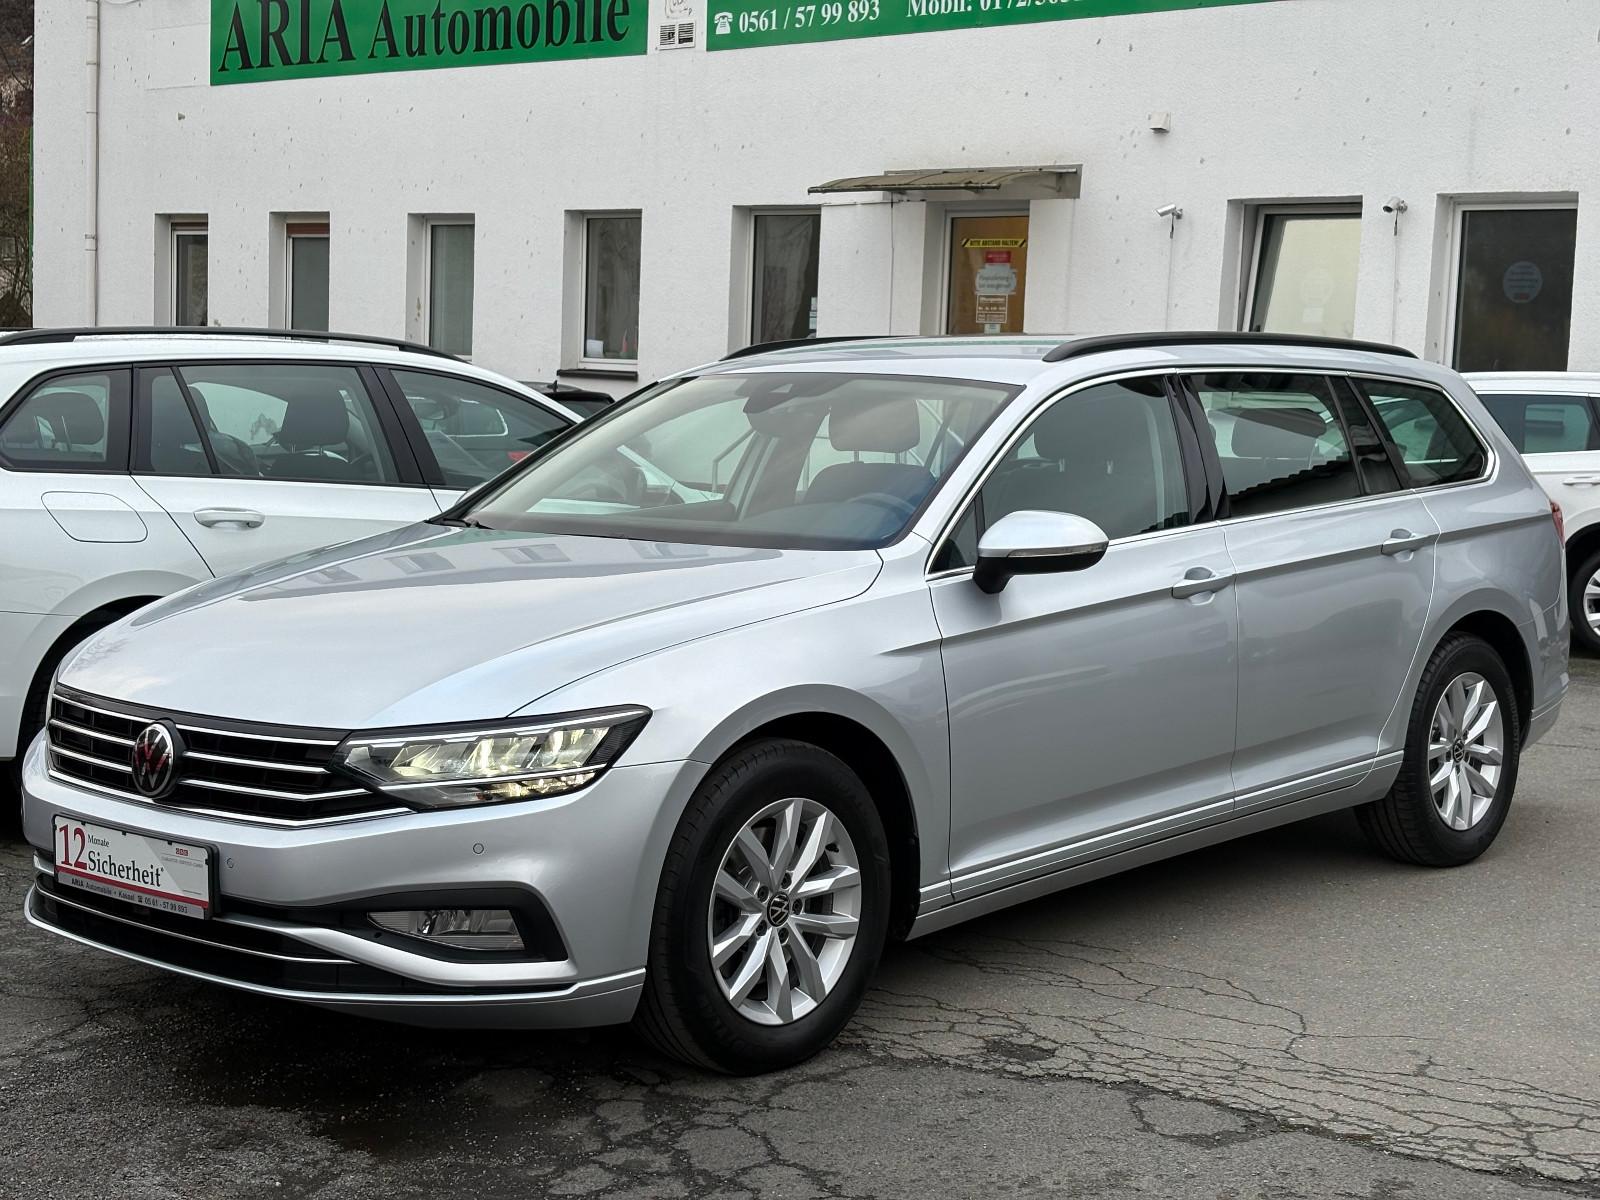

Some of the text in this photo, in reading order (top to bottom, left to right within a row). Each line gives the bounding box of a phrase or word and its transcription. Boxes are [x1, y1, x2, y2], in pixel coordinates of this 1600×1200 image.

[218, 0, 631, 72] ARIA Automobile
[738, 11, 777, 33] 0561
[795, 5, 816, 28] 57
[821, 2, 843, 26] 99
[847, 0, 880, 23] 893
[59, 823, 110, 871] 12 Monate
[71, 877, 84, 888] ARIA
